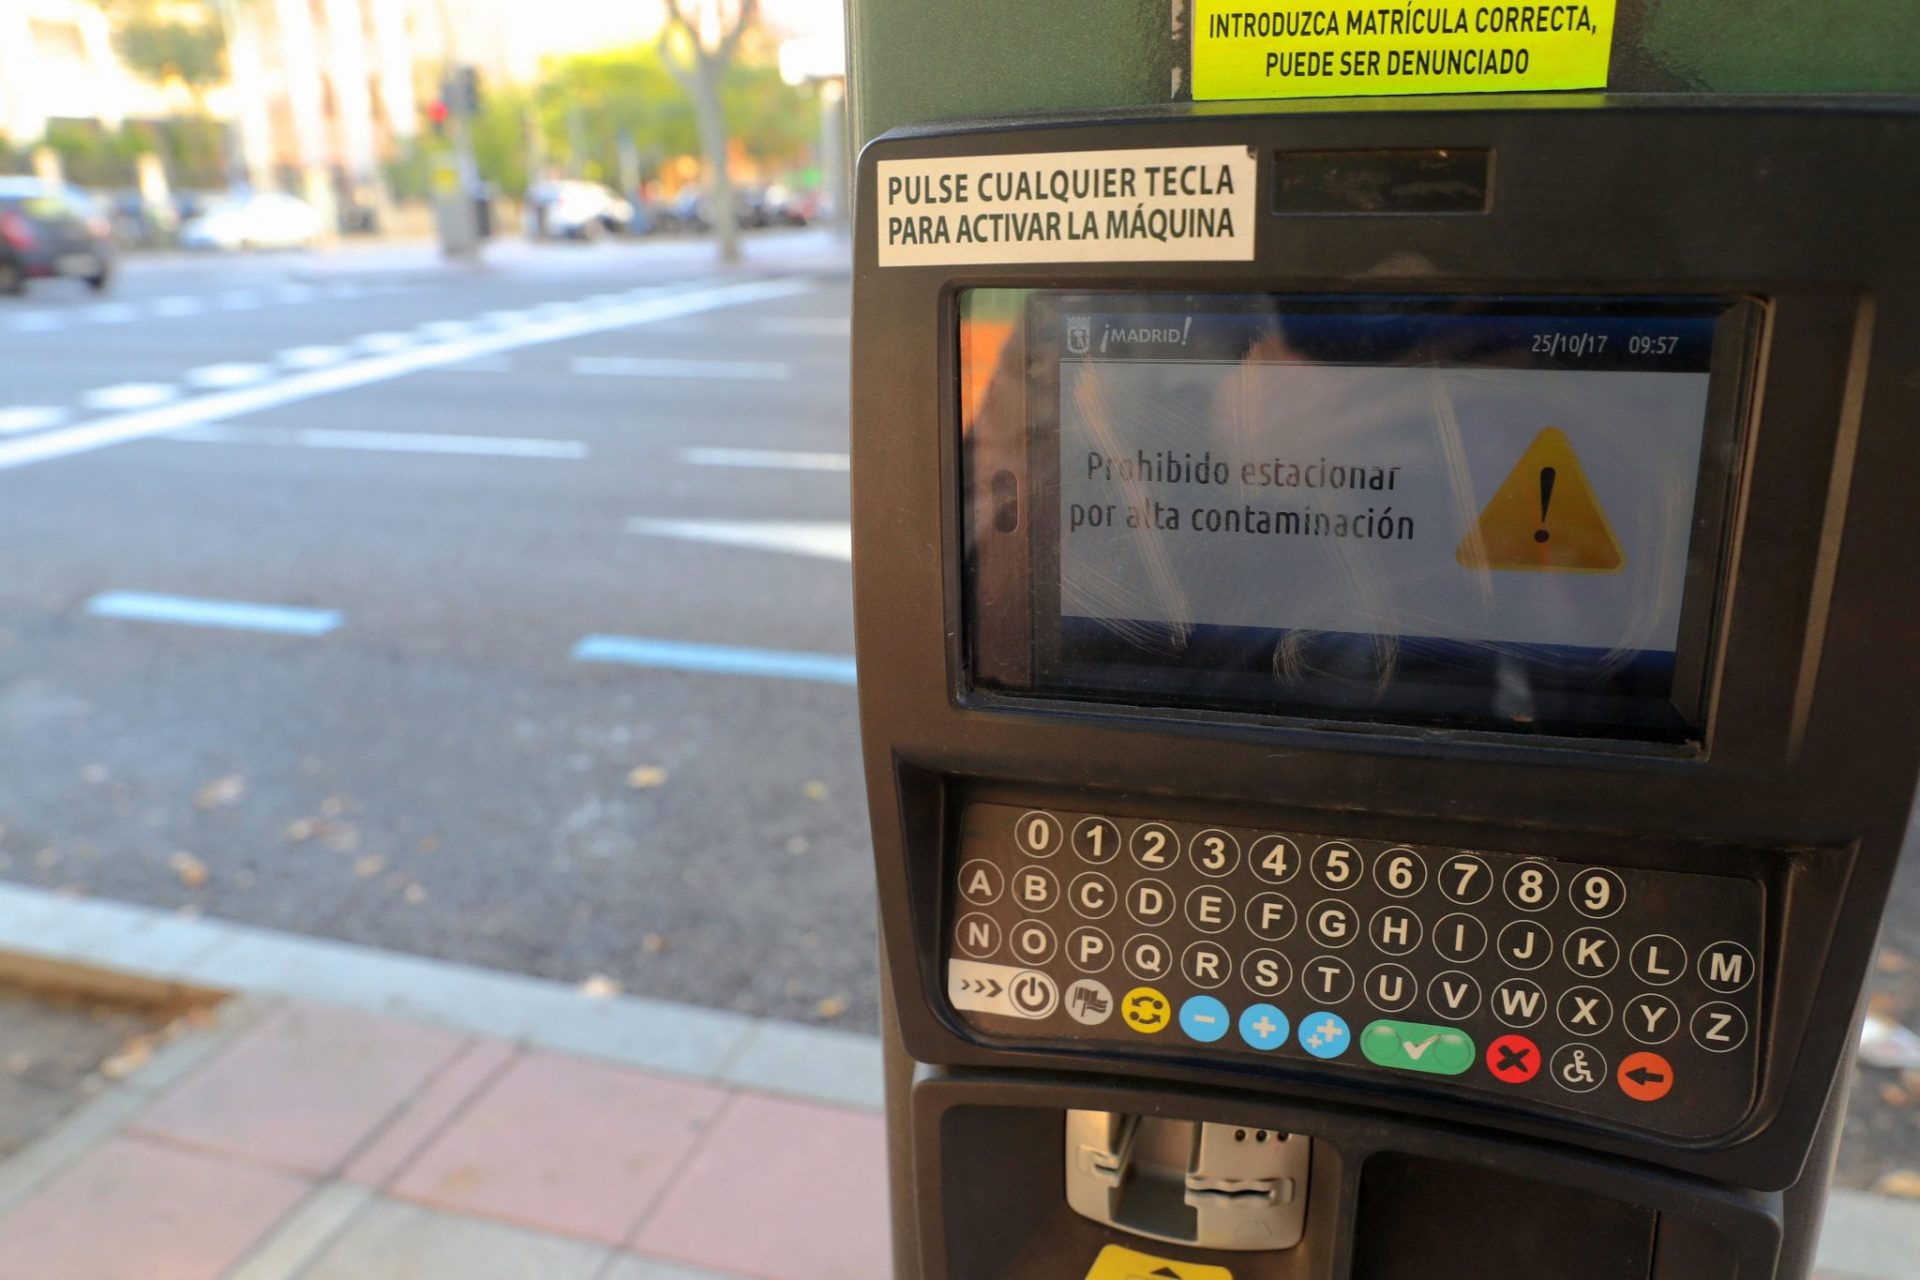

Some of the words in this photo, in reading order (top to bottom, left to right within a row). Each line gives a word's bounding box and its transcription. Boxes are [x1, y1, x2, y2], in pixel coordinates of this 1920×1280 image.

[1209, 11, 1340, 39] INTRODUZCA
[1345, 1, 1469, 36] MATRÍCULA
[1474, 5, 1598, 37] CORRECTA,
[1265, 51, 1335, 78] PUEDE
[1338, 50, 1381, 77] SER
[1386, 48, 1530, 77] DENUNCIADO
[888, 173, 969, 206] PULSE
[977, 166, 1137, 204] CUALQUIER
[1143, 163, 1236, 197] TECLA
[888, 215, 951, 246] PARA
[955, 211, 1062, 244] ACTIVAR
[1067, 210, 1100, 241] LA
[1105, 202, 1236, 243] MÁQUINA
[1100, 316, 1193, 354] ¡MADRID!
[1531, 332, 1609, 354] 25/10/17
[1628, 335, 1679, 354] 09:57
[1087, 449, 1230, 486] Prohibido
[1240, 456, 1402, 491] estacionar
[1070, 503, 1117, 533] por
[1126, 497, 1180, 531] alta
[1191, 504, 1415, 542] contaminación
[1027, 818, 1050, 851] 0
[1086, 824, 1103, 857] 1
[1141, 830, 1166, 864] 2
[1202, 836, 1226, 870] 3
[1261, 843, 1287, 877] 4
[1325, 849, 1350, 883] 5
[1388, 856, 1413, 890] 6
[1453, 862, 1479, 896] 7
[1518, 869, 1544, 904] 8
[1584, 876, 1610, 910] 9
[967, 869, 993, 897] A
[1024, 874, 1048, 902] B
[1080, 881, 1105, 909] C
[1138, 887, 1163, 915] D
[1199, 895, 1222, 924] E
[1261, 902, 1284, 930] F
[1318, 909, 1346, 938] G
[1382, 916, 1409, 946] H
[1454, 923, 1465, 952] I
[1512, 931, 1535, 959] J
[1577, 937, 1607, 968] K
[1647, 945, 1670, 976] L
[1709, 952, 1743, 984] M
[968, 921, 990, 948] N
[1021, 928, 1047, 955] O
[1080, 935, 1104, 963] P
[1135, 944, 1161, 973] Q
[1195, 951, 1220, 980] R
[1255, 959, 1279, 987] S
[1317, 966, 1341, 993] T
[1379, 974, 1403, 1002] U
[1442, 981, 1469, 1009] V
[1500, 988, 1541, 1018] W
[1570, 996, 1600, 1026] X
[1639, 1004, 1668, 1033] Y
[1705, 1012, 1732, 1042] Z
